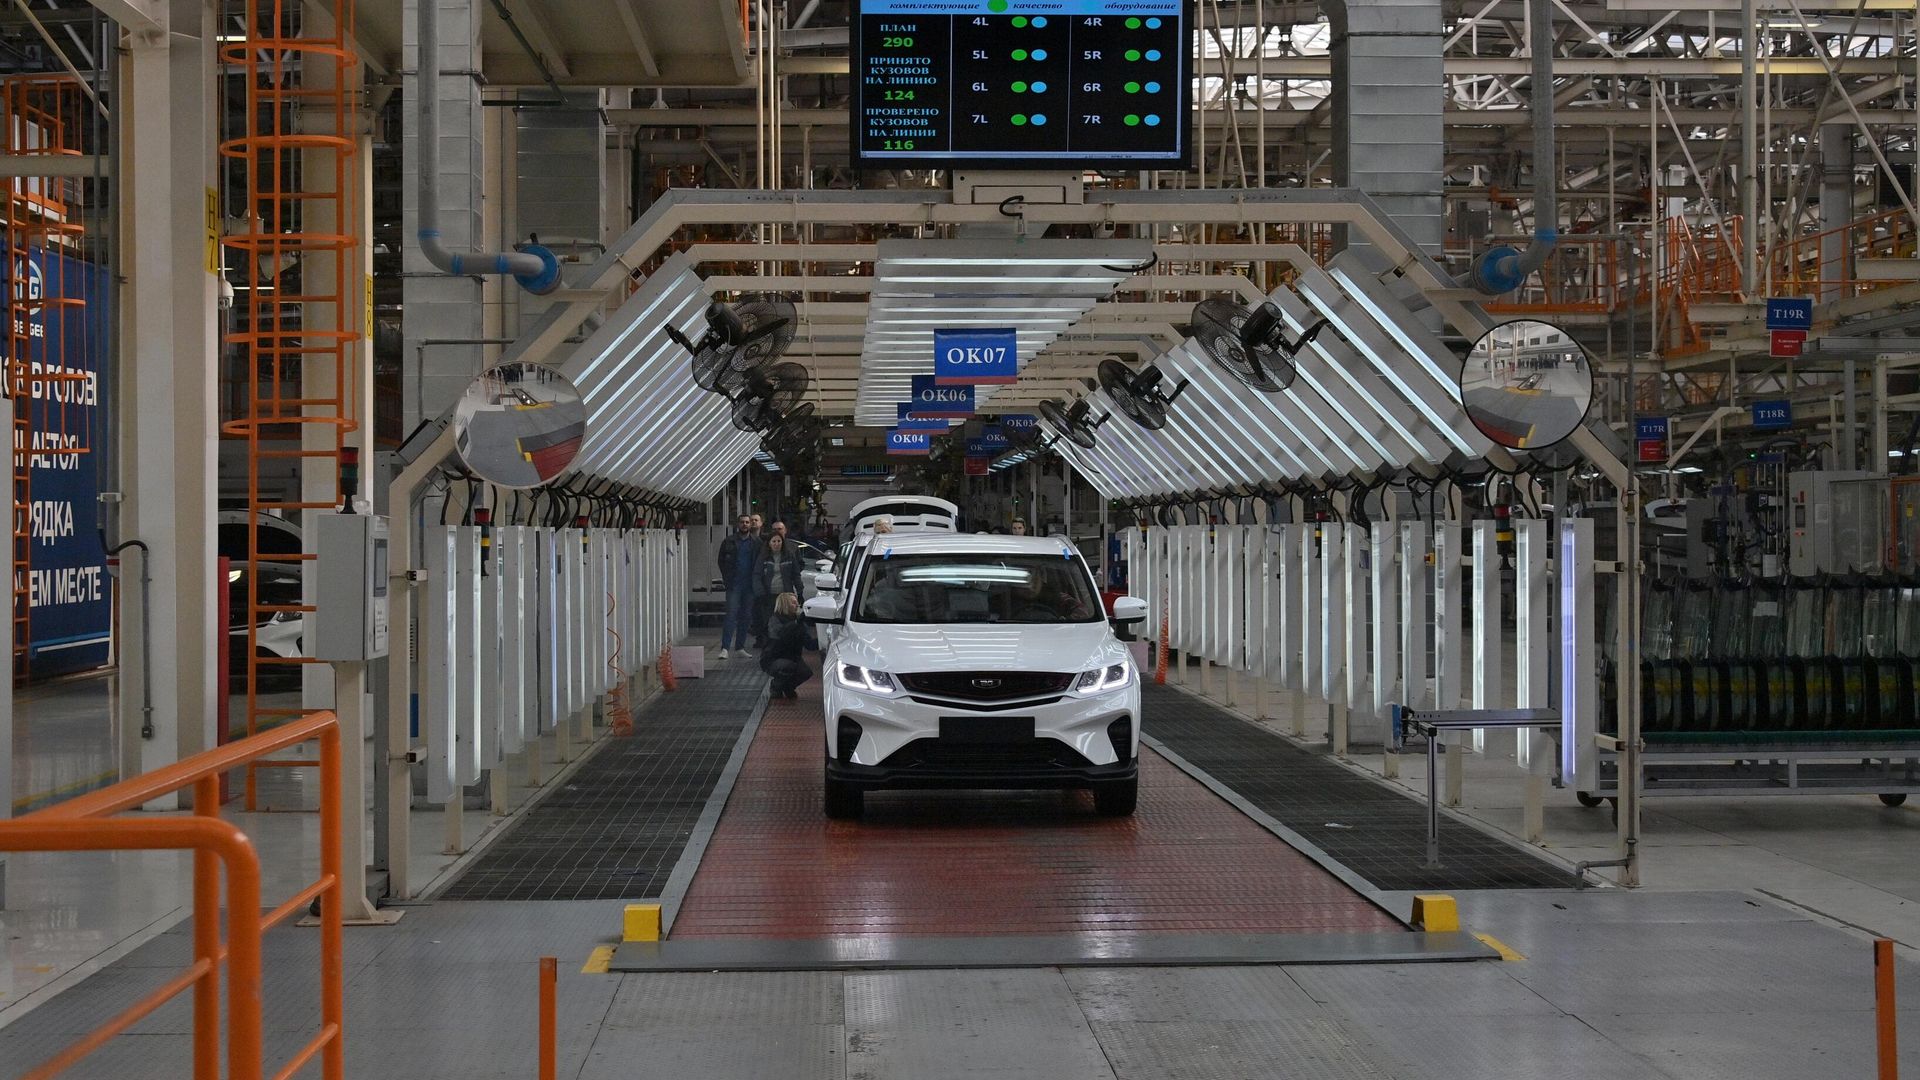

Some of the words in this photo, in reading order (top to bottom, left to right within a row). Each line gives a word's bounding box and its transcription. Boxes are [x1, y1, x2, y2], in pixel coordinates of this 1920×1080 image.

[1104, 2, 1177, 10] оборудование
[972, 17, 989, 26] 4L
[1084, 17, 1102, 26] 4R
[880, 24, 916, 32] ПЛАН
[883, 37, 914, 47] 290
[972, 50, 989, 60] 5L
[1084, 50, 1102, 60] 5R
[870, 57, 931, 65] ПРИНЯТО
[871, 67, 929, 75] КУЗОВОВ
[865, 77, 883, 85] НА
[886, 77, 937, 85] ЛИНИЮ
[972, 82, 989, 92] 6L
[1083, 82, 1102, 92] 6R
[884, 90, 915, 100] 124
[866, 108, 939, 116] ПРОВЕРЕНО
[870, 118, 929, 126] КУЗОВОВ
[971, 114, 989, 124] 7L
[1083, 115, 1101, 124] 7R
[869, 129, 887, 137] НА
[889, 129, 936, 137] ЛИНИИ
[884, 140, 914, 150] 116
[1774, 308, 1804, 319] T19R
[947, 347, 1006, 364] OK07
[921, 389, 967, 402] OK06
[1758, 410, 1785, 419] T18R
[1006, 419, 1033, 427] OK03
[1641, 425, 1665, 433] T17R
[893, 434, 924, 443] OK04
[986, 434, 1008, 442] OK0
[55, 566, 101, 604] МЕСТЕ
